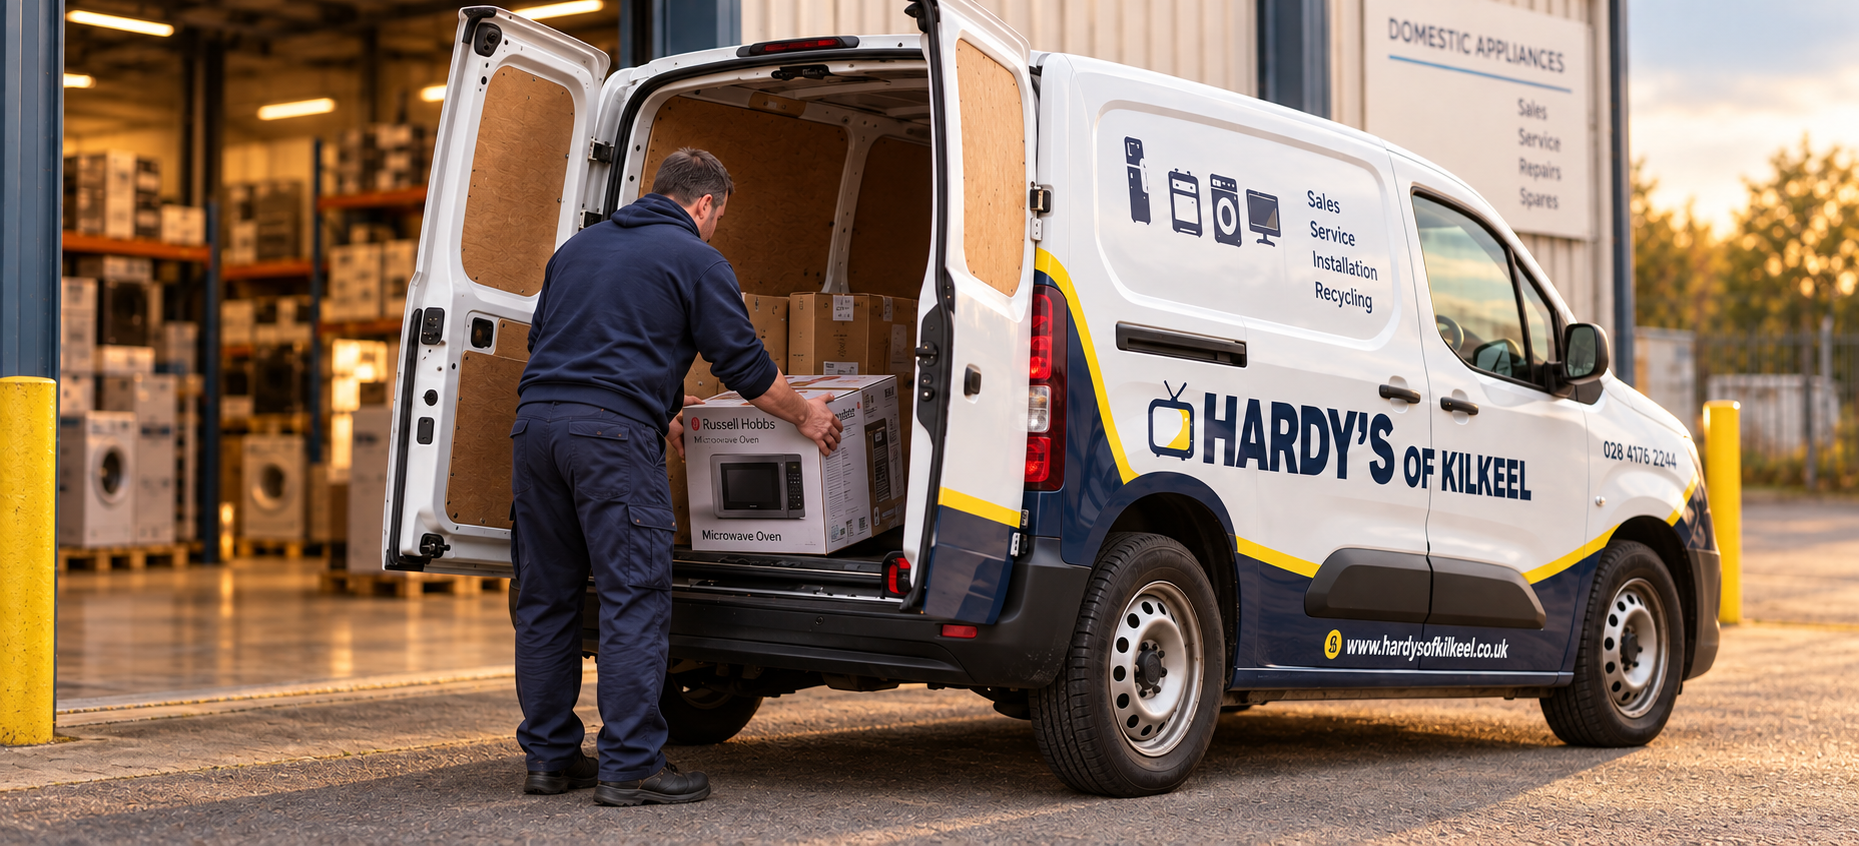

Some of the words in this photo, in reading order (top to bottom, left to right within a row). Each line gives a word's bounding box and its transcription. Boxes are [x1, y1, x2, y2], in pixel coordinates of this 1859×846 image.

[1389, 18, 1471, 54] DOMESTIC
[1475, 37, 1565, 73] APPLIANCES
[1518, 98, 1548, 121] Sales
[1518, 128, 1561, 152] Service
[1519, 157, 1561, 181] Repairs
[1307, 189, 1341, 214] Sales
[1520, 187, 1559, 211] Spares
[1310, 220, 1356, 247] Service
[1312, 250, 1378, 281] Installation
[1315, 281, 1373, 314] Recycling
[702, 417, 739, 430] Russell
[741, 417, 776, 430] Hobbs
[739, 435, 759, 444] Oven
[1202, 392, 1395, 485] HARDY'S
[1403, 445, 1435, 489] OF
[1441, 449, 1532, 501] KILKEEL
[1603, 440, 1624, 461] 028
[1627, 444, 1650, 465] 4176
[1653, 448, 1677, 470] 2244
[701, 529, 754, 541] Microwave
[756, 530, 782, 542] Oven
[1346, 634, 1509, 662] www.hardysofkilkeel.co.uk
